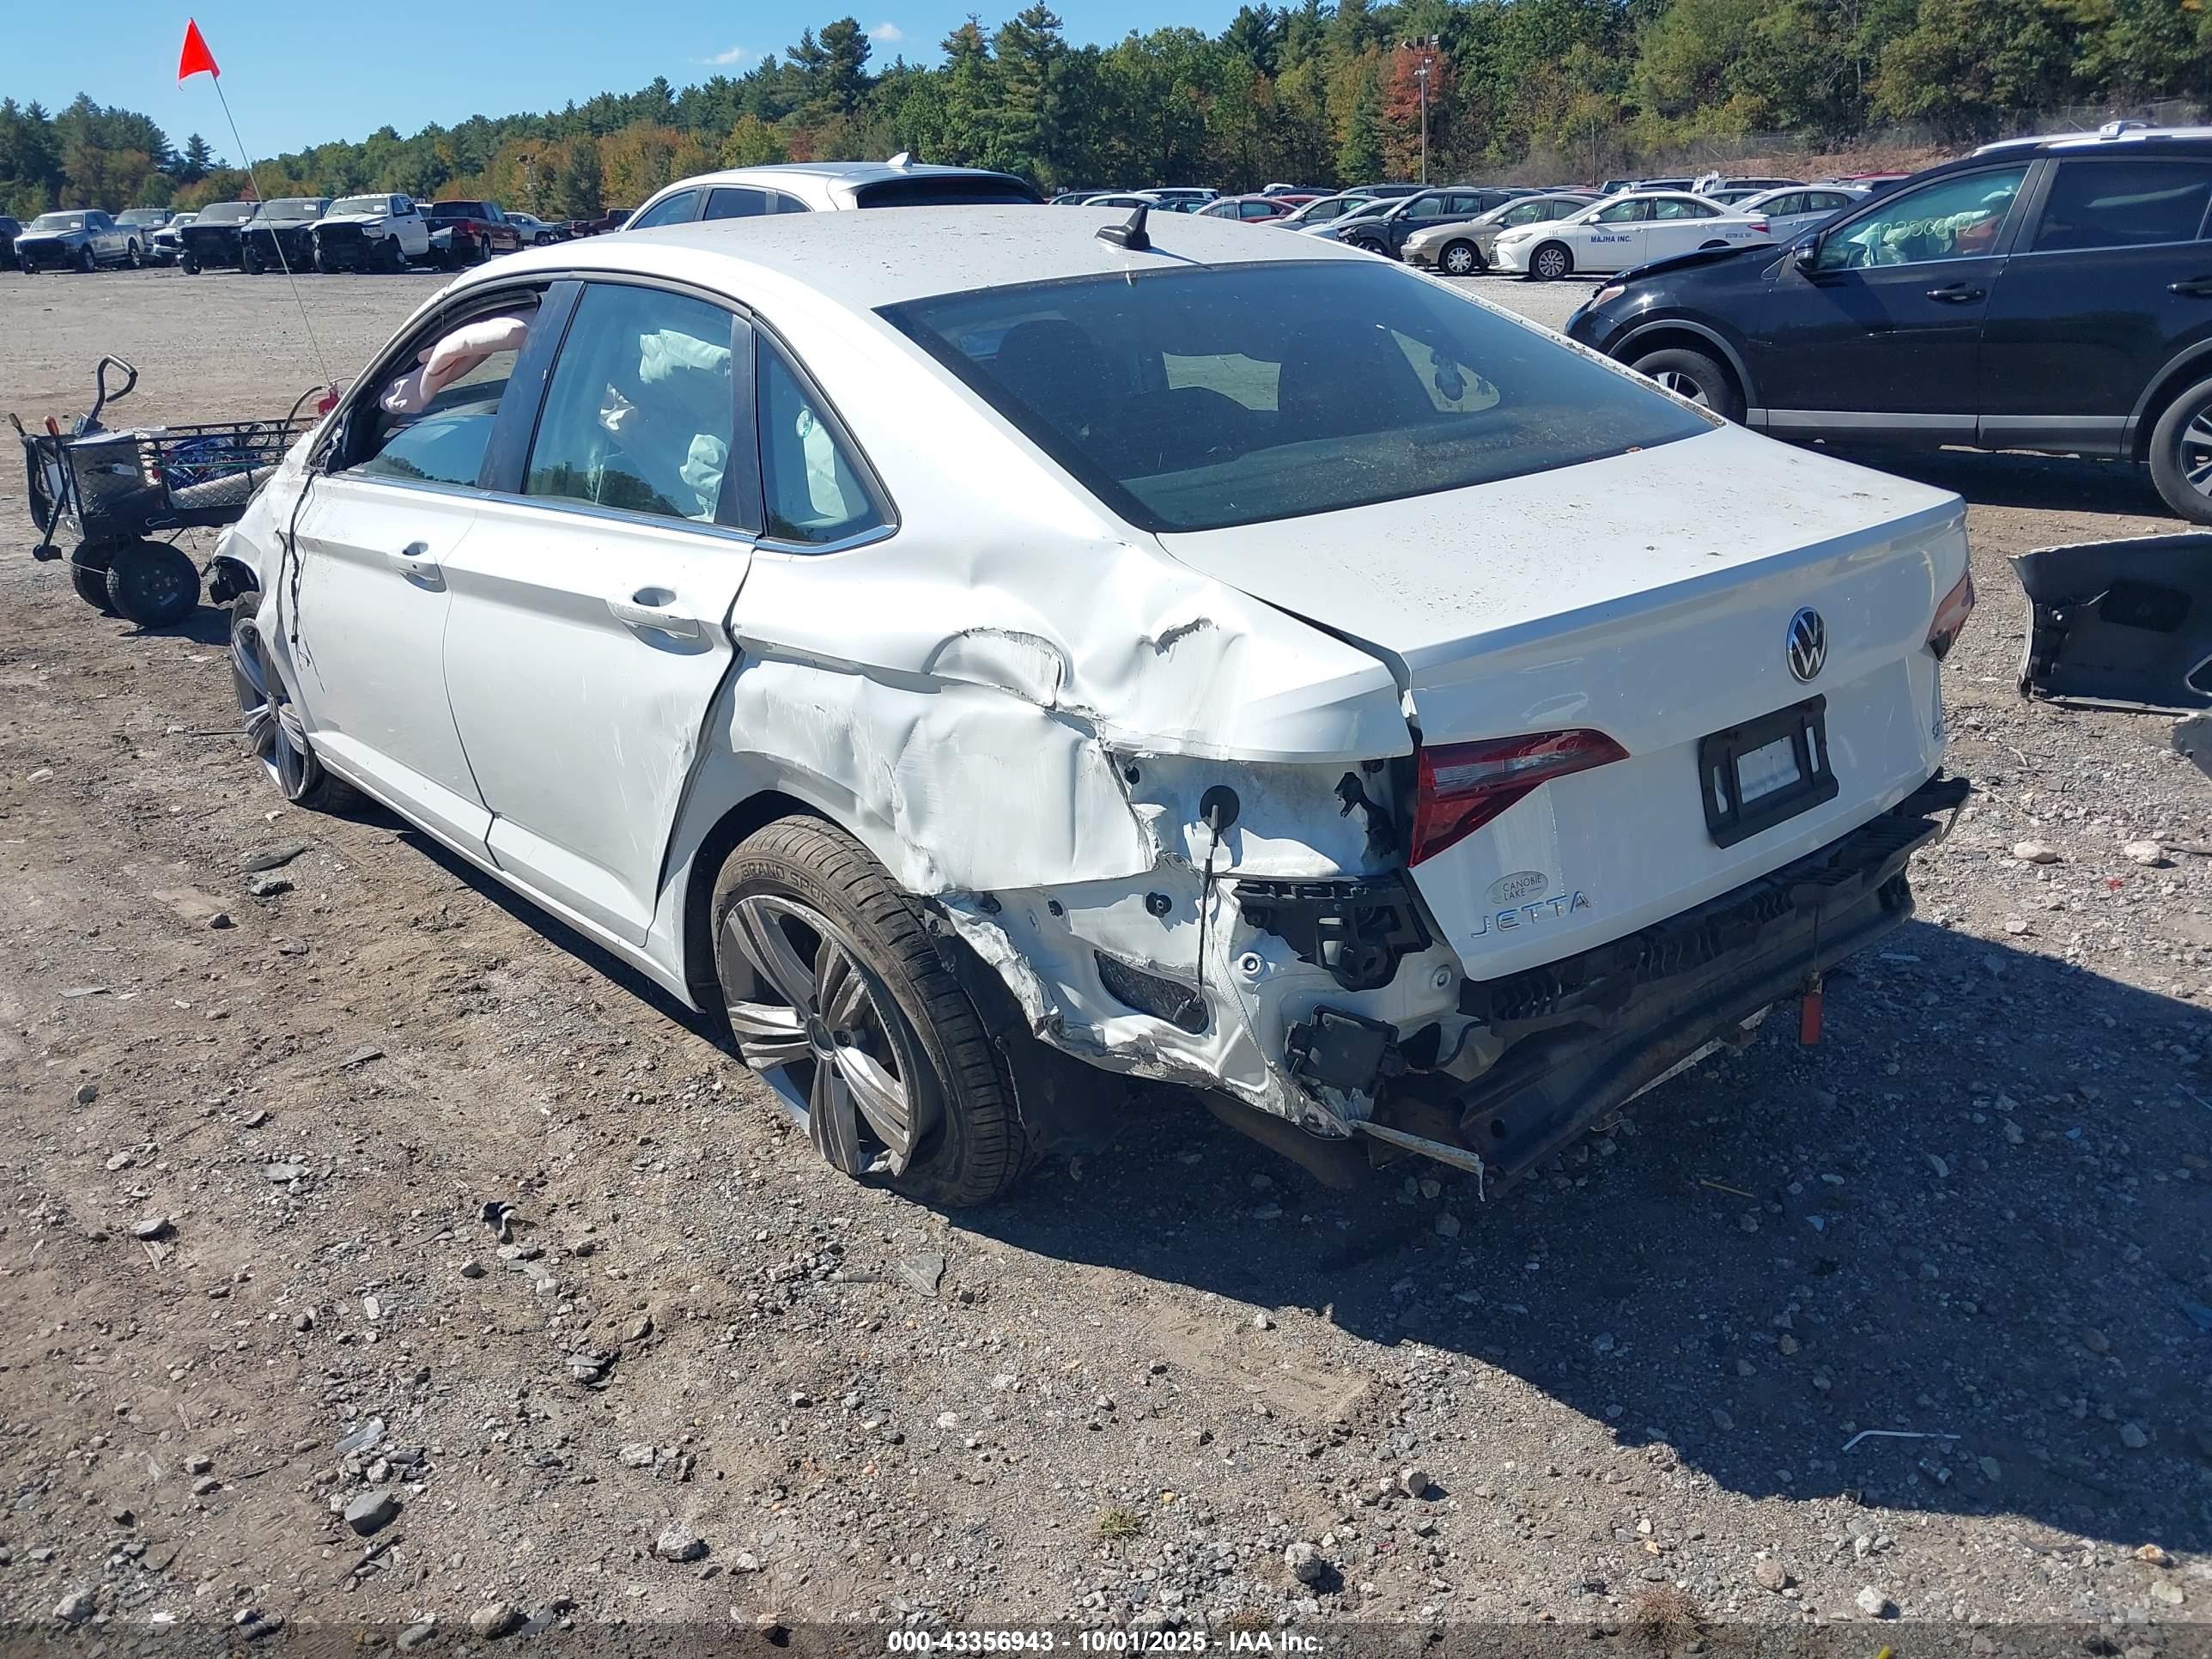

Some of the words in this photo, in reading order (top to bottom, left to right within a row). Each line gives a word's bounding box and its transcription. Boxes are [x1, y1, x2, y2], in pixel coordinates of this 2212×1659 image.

[741, 861, 786, 879] GRAND
[1503, 875, 1541, 892] CANOBIE
[1504, 887, 1526, 901] LAKE
[1470, 890, 1591, 939] JETTA
